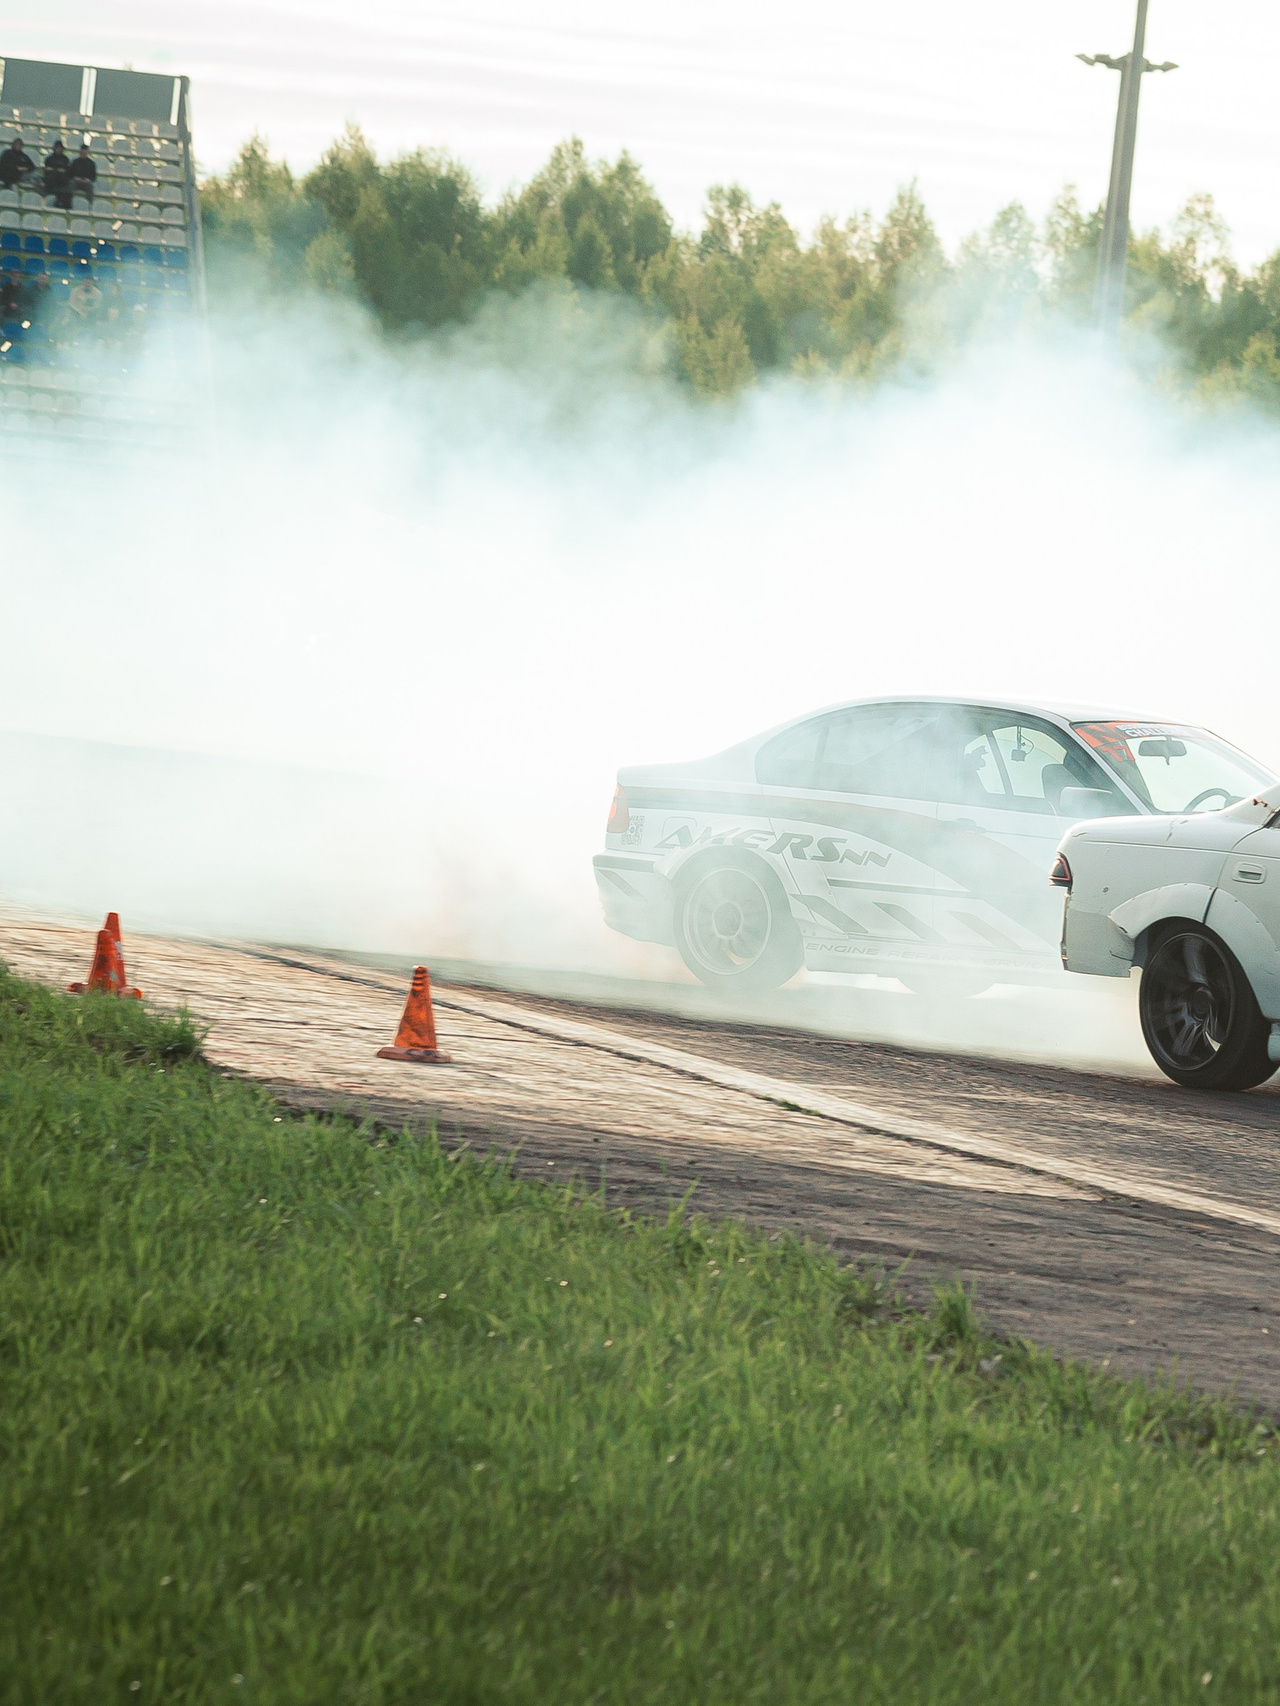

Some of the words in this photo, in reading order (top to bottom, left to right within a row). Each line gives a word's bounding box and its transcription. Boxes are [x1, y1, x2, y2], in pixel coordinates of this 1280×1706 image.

[1101, 745, 1136, 763] 17
[805, 942, 881, 956] ENGINE
[886, 950, 960, 963] REPAIR
[967, 956, 1055, 971] SERVIC
